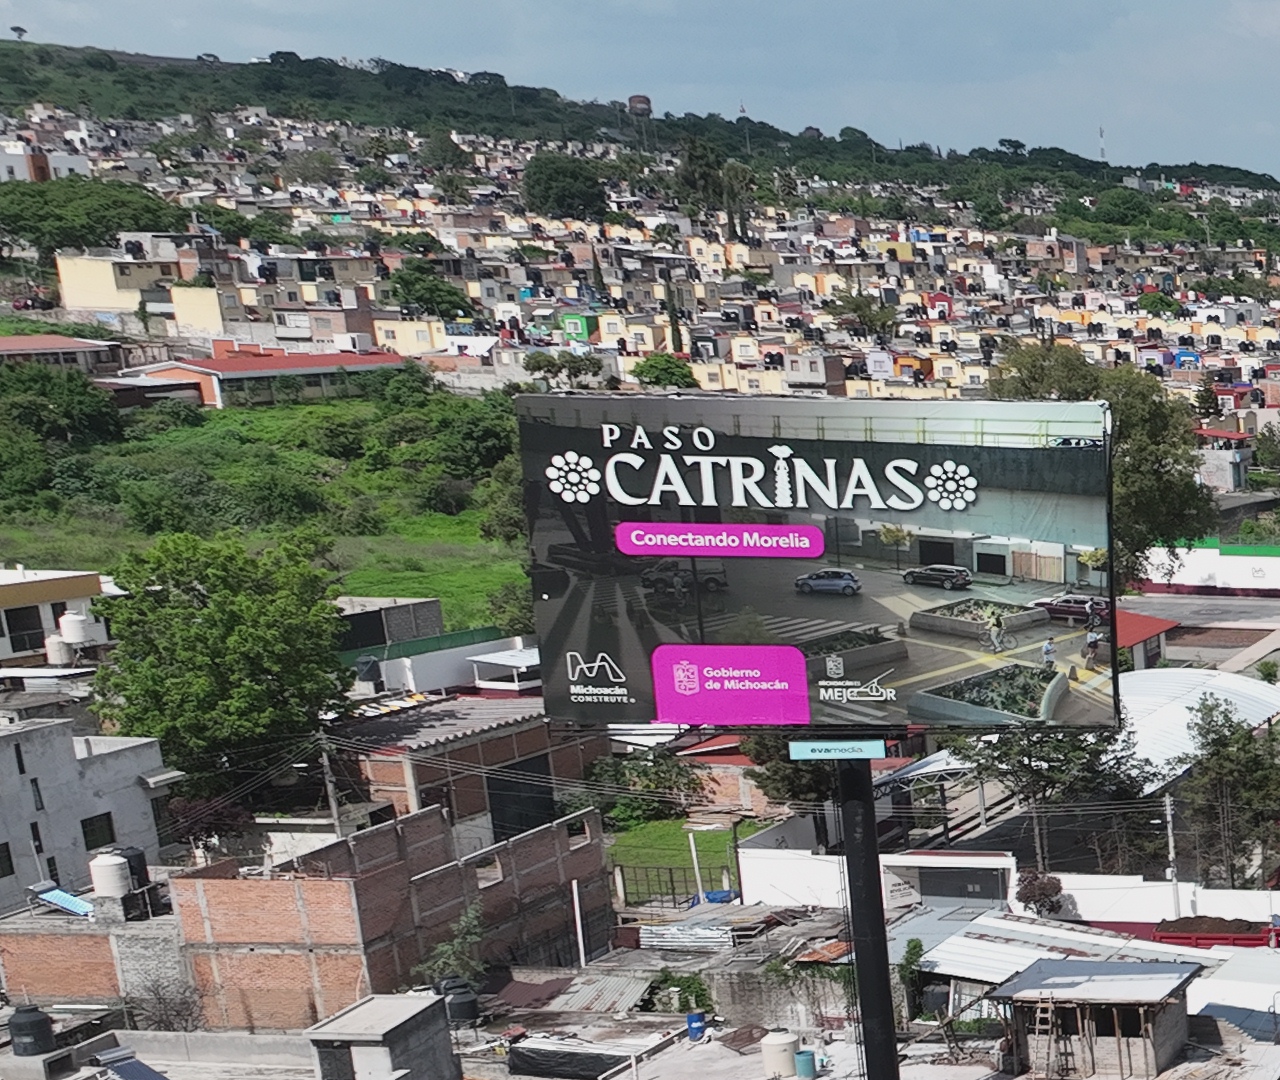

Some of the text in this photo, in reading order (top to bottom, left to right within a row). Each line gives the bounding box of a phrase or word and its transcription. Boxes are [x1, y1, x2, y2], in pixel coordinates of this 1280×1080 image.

[601, 423, 717, 451] PASO
[604, 445, 925, 511] CATRINAS
[630, 529, 811, 550] Conectando Morelia
[703, 666, 761, 679] Gobierno
[570, 684, 628, 696] Michoacán
[705, 678, 789, 692] de Michoacán
[570, 695, 629, 704] CONSTRUYE
